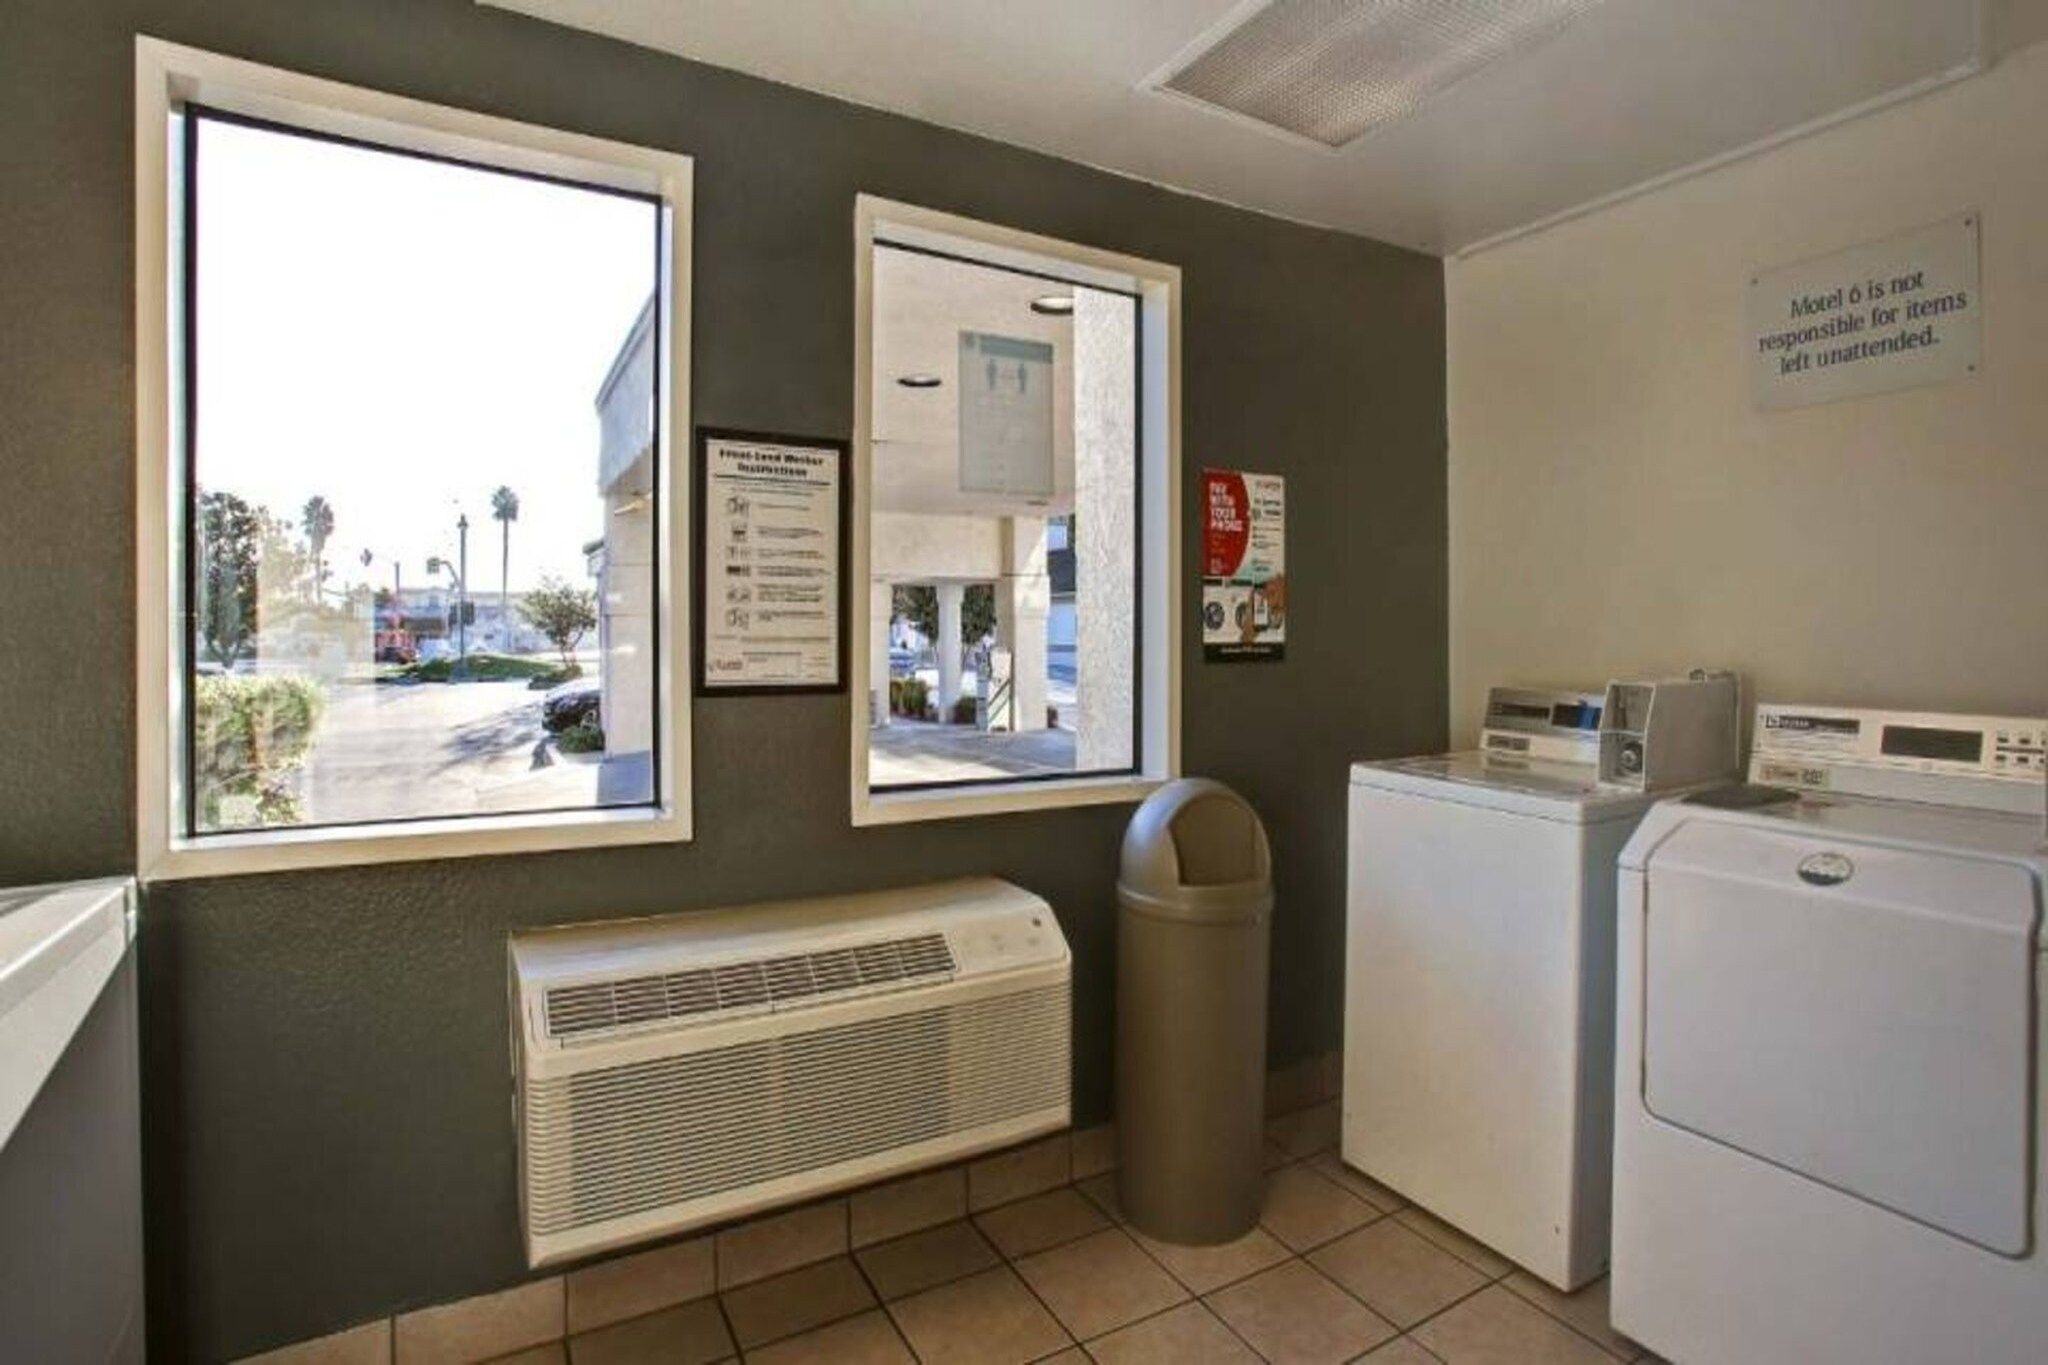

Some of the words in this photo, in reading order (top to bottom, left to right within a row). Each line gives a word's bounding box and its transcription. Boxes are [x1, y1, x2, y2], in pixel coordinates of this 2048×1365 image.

[1791, 288, 1843, 318] Motel
[1850, 286, 1861, 304] 6
[1868, 280, 1885, 299] is
[1891, 271, 1924, 294] not
[1759, 313, 1865, 352] responsible
[1872, 306, 1899, 327] for
[1906, 291, 1967, 320] items
[1780, 352, 1809, 375] left
[1817, 325, 1940, 366] unattended.
